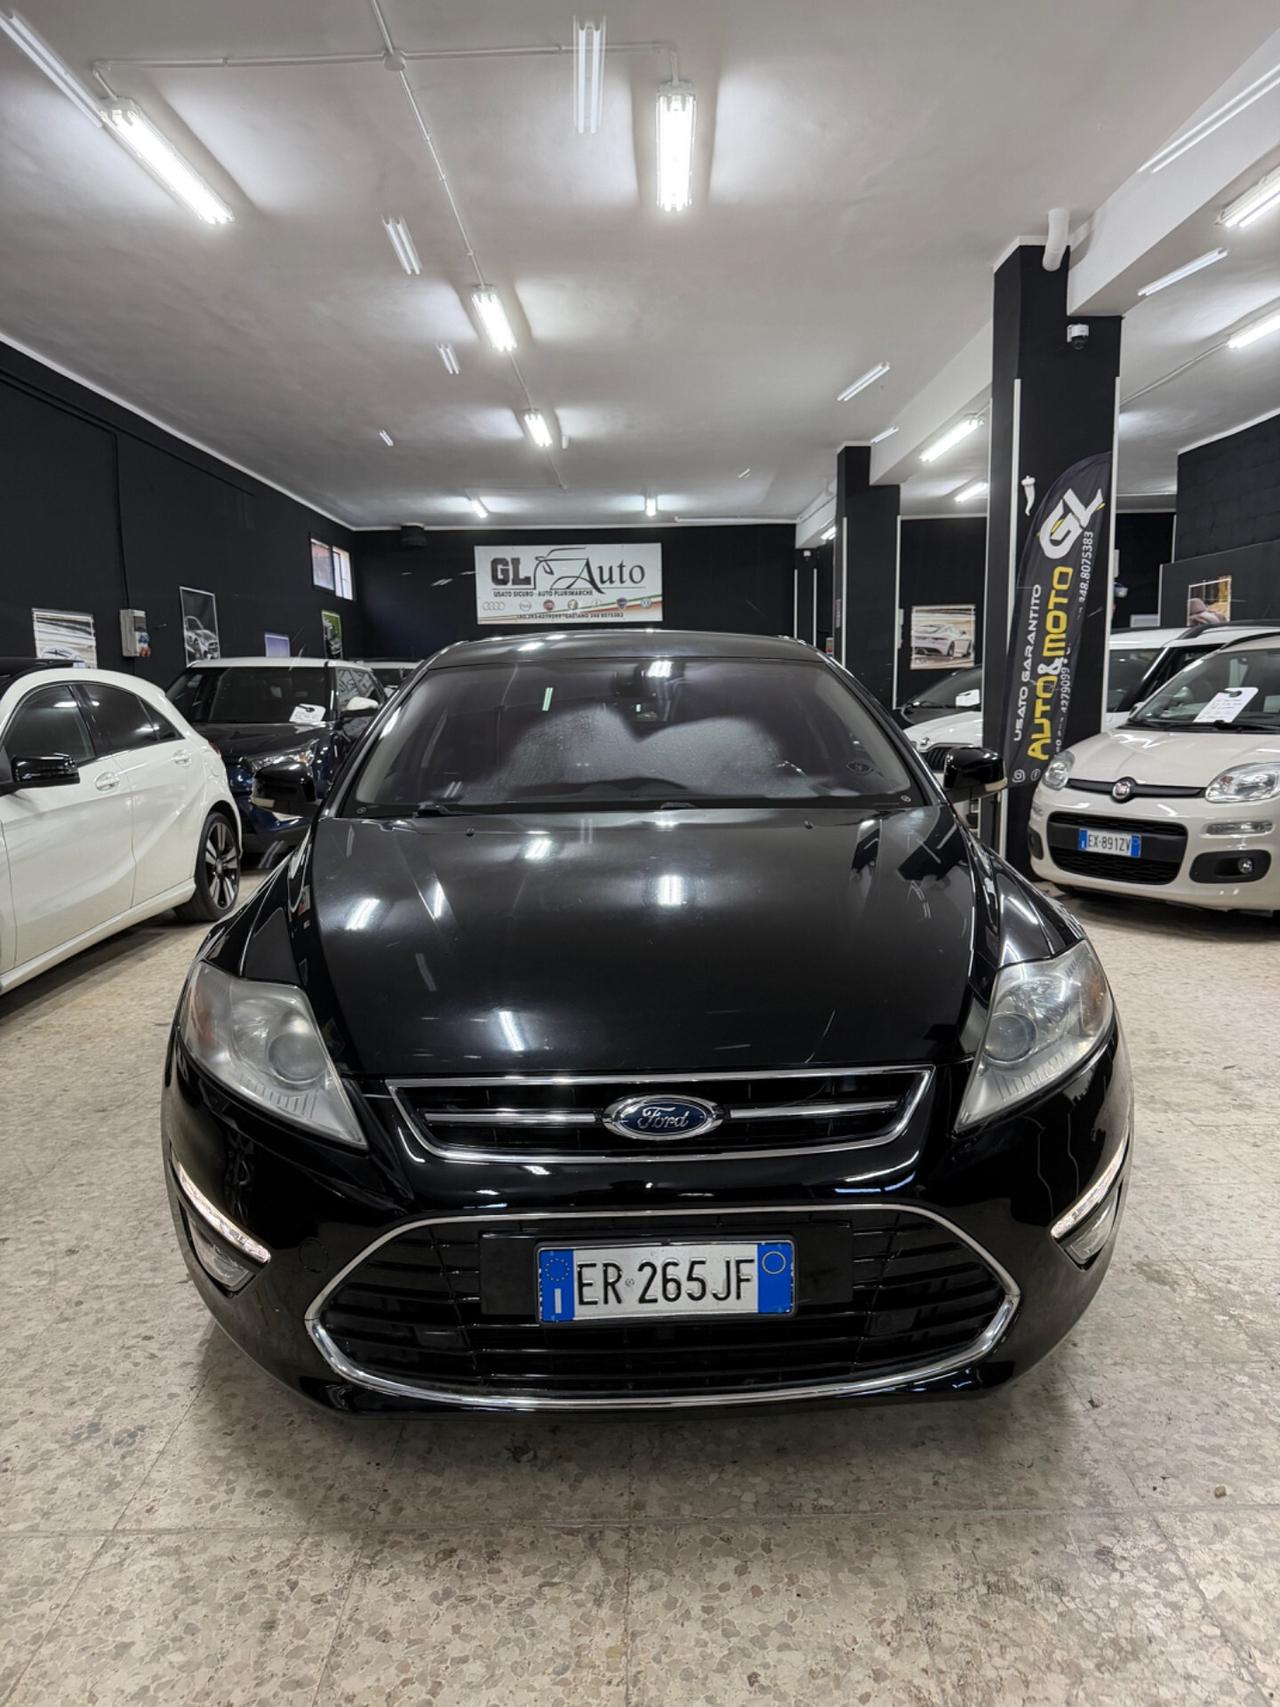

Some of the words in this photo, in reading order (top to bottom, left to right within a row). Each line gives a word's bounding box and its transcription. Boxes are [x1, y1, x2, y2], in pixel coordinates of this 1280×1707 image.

[1039, 488, 1104, 560] GL
[490, 557, 531, 586] GL
[566, 557, 646, 594] Auto
[493, 590, 512, 598] USATO
[513, 590, 534, 598] SICURO
[1013, 686, 1029, 742] USATO
[1021, 584, 1042, 682] GARANTITO
[637, 1106, 690, 1129] Ford
